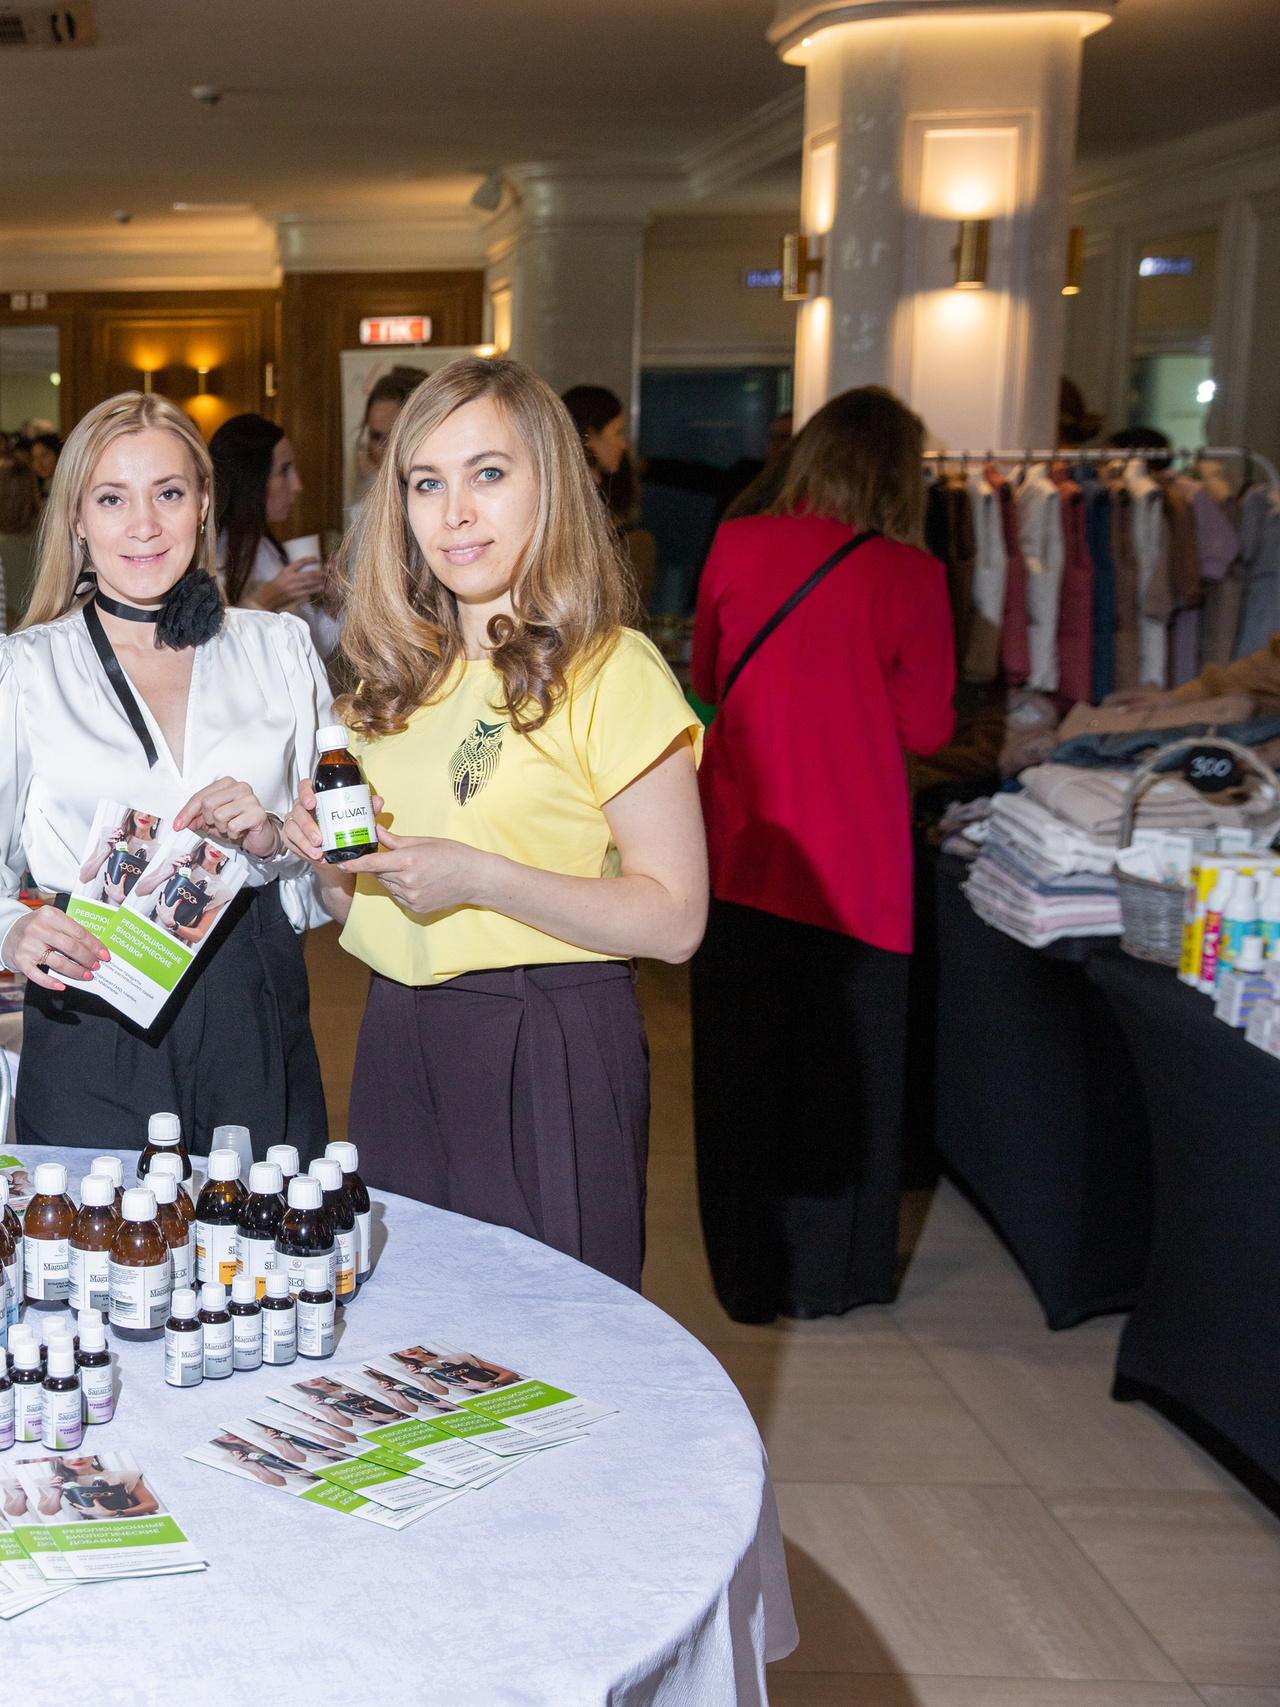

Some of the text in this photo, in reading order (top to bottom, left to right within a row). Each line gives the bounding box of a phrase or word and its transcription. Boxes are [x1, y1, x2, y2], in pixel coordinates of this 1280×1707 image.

[331, 806, 366, 821] FULVAT
[110, 934, 143, 959] ДОБАВКИ
[115, 926, 173, 968] БИОЛОГИЧЕСКИЕ
[121, 918, 182, 964] РЕВОЛЮЦИОННЫЕ
[62, 1521, 165, 1535] РЕВОЛЮЦИОННЫЕ
[66, 1528, 161, 1540] БИОЛОГИЧЕСКИЕ
[70, 1537, 122, 1546] ДОБАВКИ
